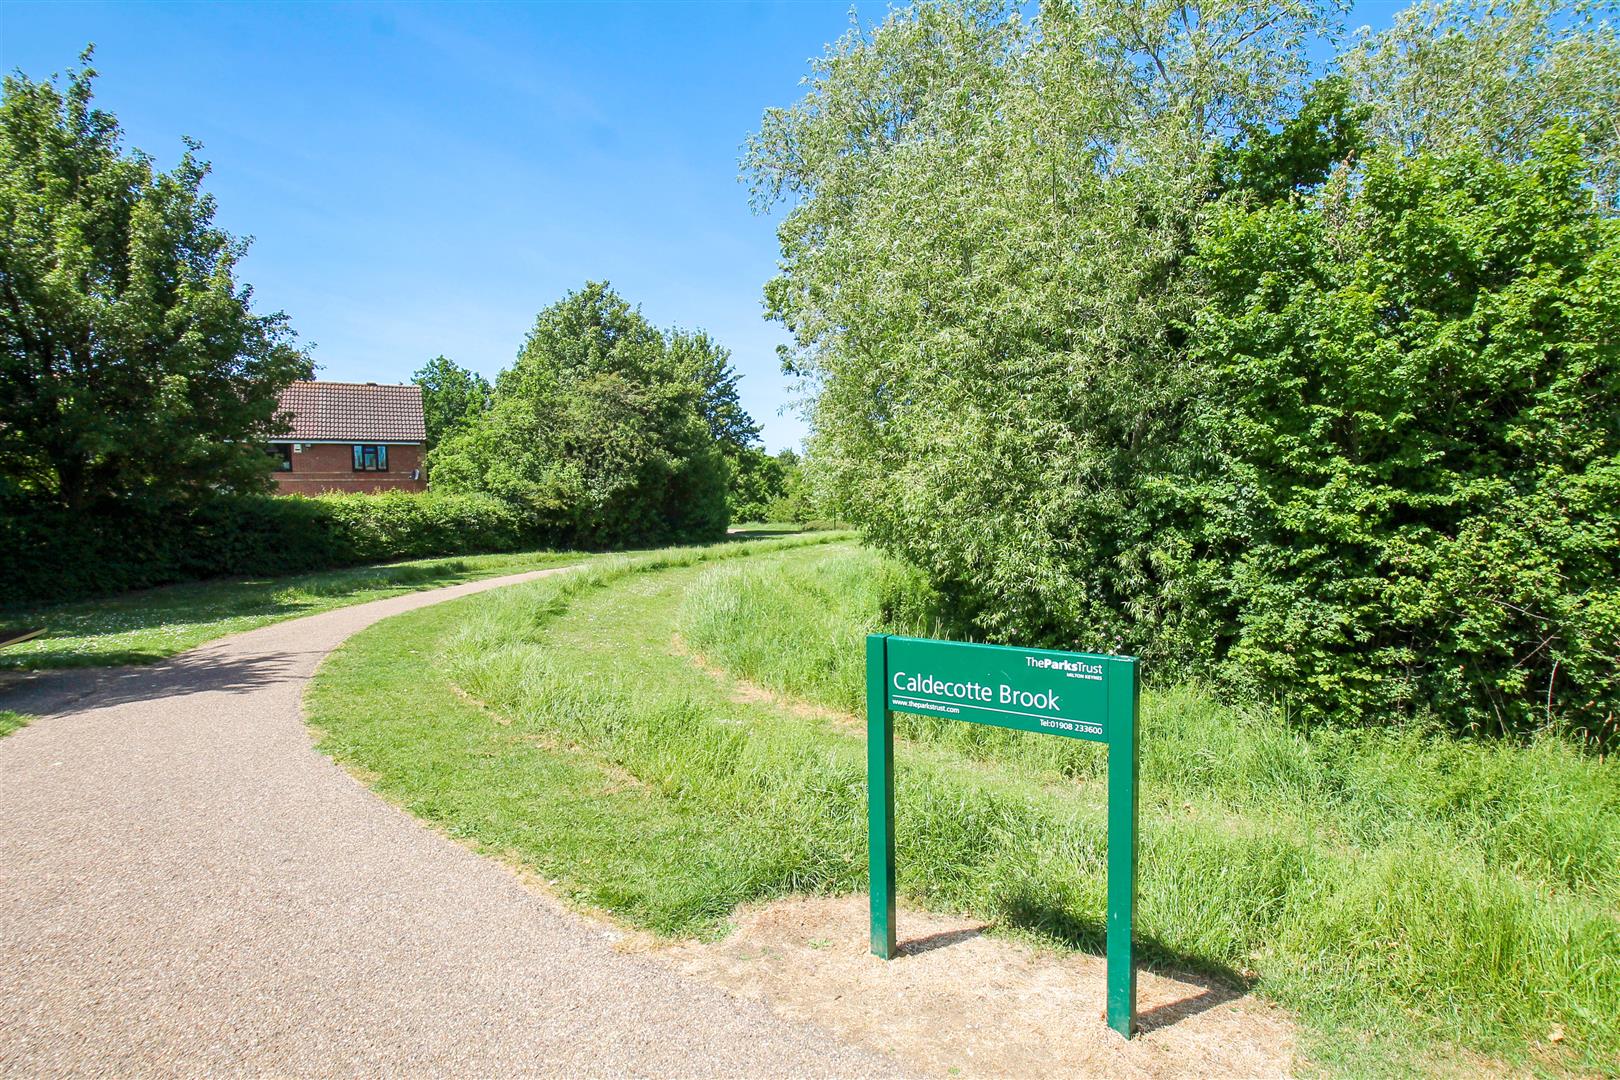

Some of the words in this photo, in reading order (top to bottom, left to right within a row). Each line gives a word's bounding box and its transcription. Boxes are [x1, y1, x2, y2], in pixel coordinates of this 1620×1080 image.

[893, 671, 992, 702] Caldecotte
[1000, 685, 1060, 710] Brook
[893, 700, 960, 714] www.theparkstrust.com
[1074, 724, 1102, 734] 233600
